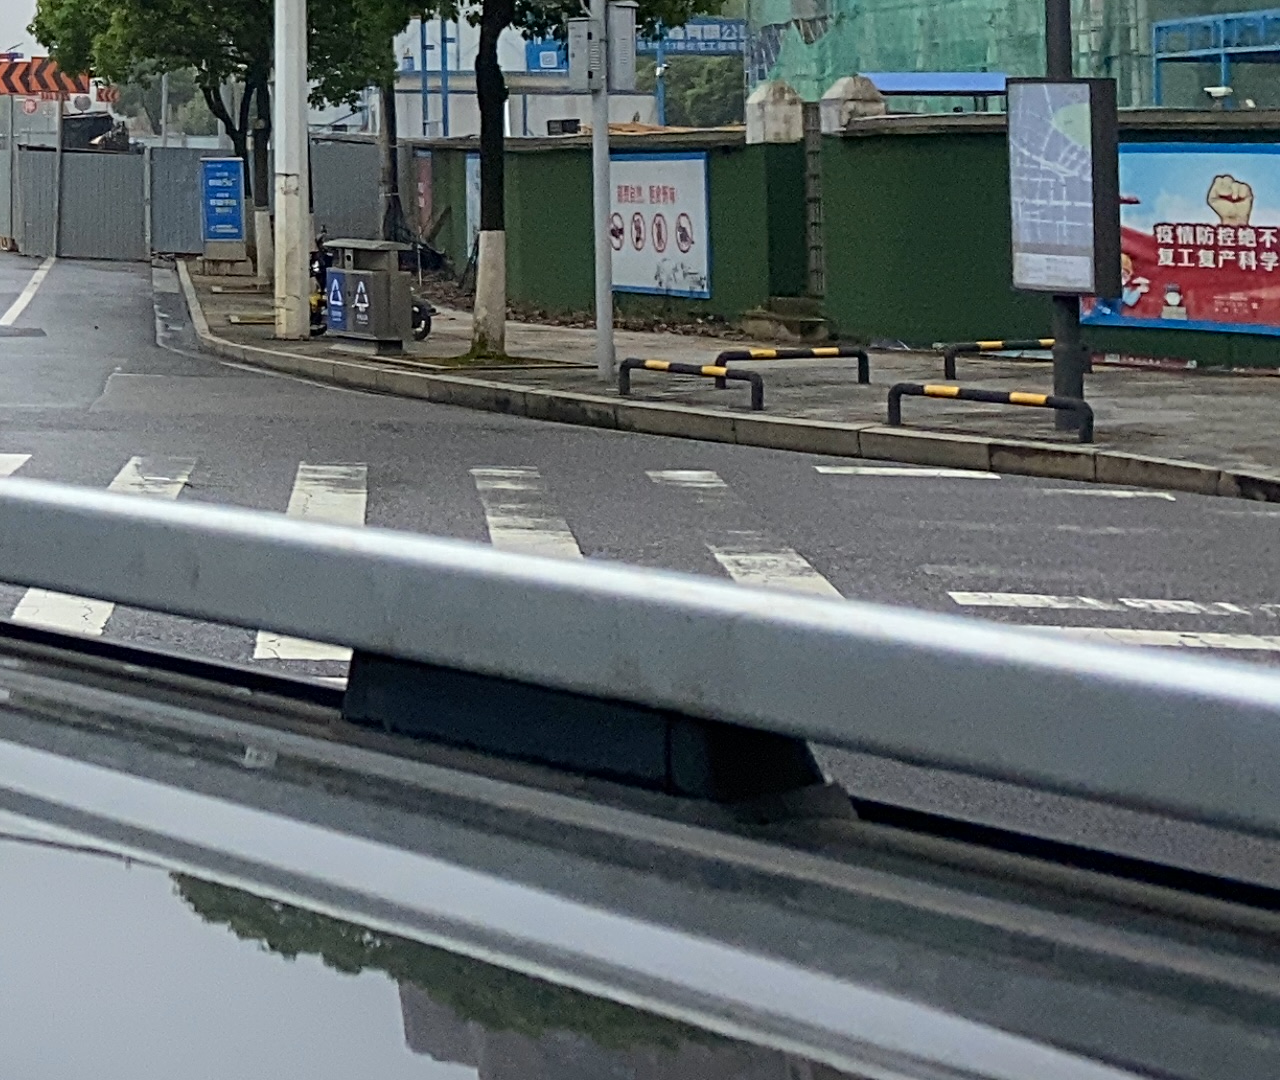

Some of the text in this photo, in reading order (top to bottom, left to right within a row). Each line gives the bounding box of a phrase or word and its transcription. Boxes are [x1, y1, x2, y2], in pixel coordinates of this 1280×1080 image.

[1156, 224, 1278, 248] 疫情防控绝不
[1157, 247, 1279, 271] 复工复产科学
